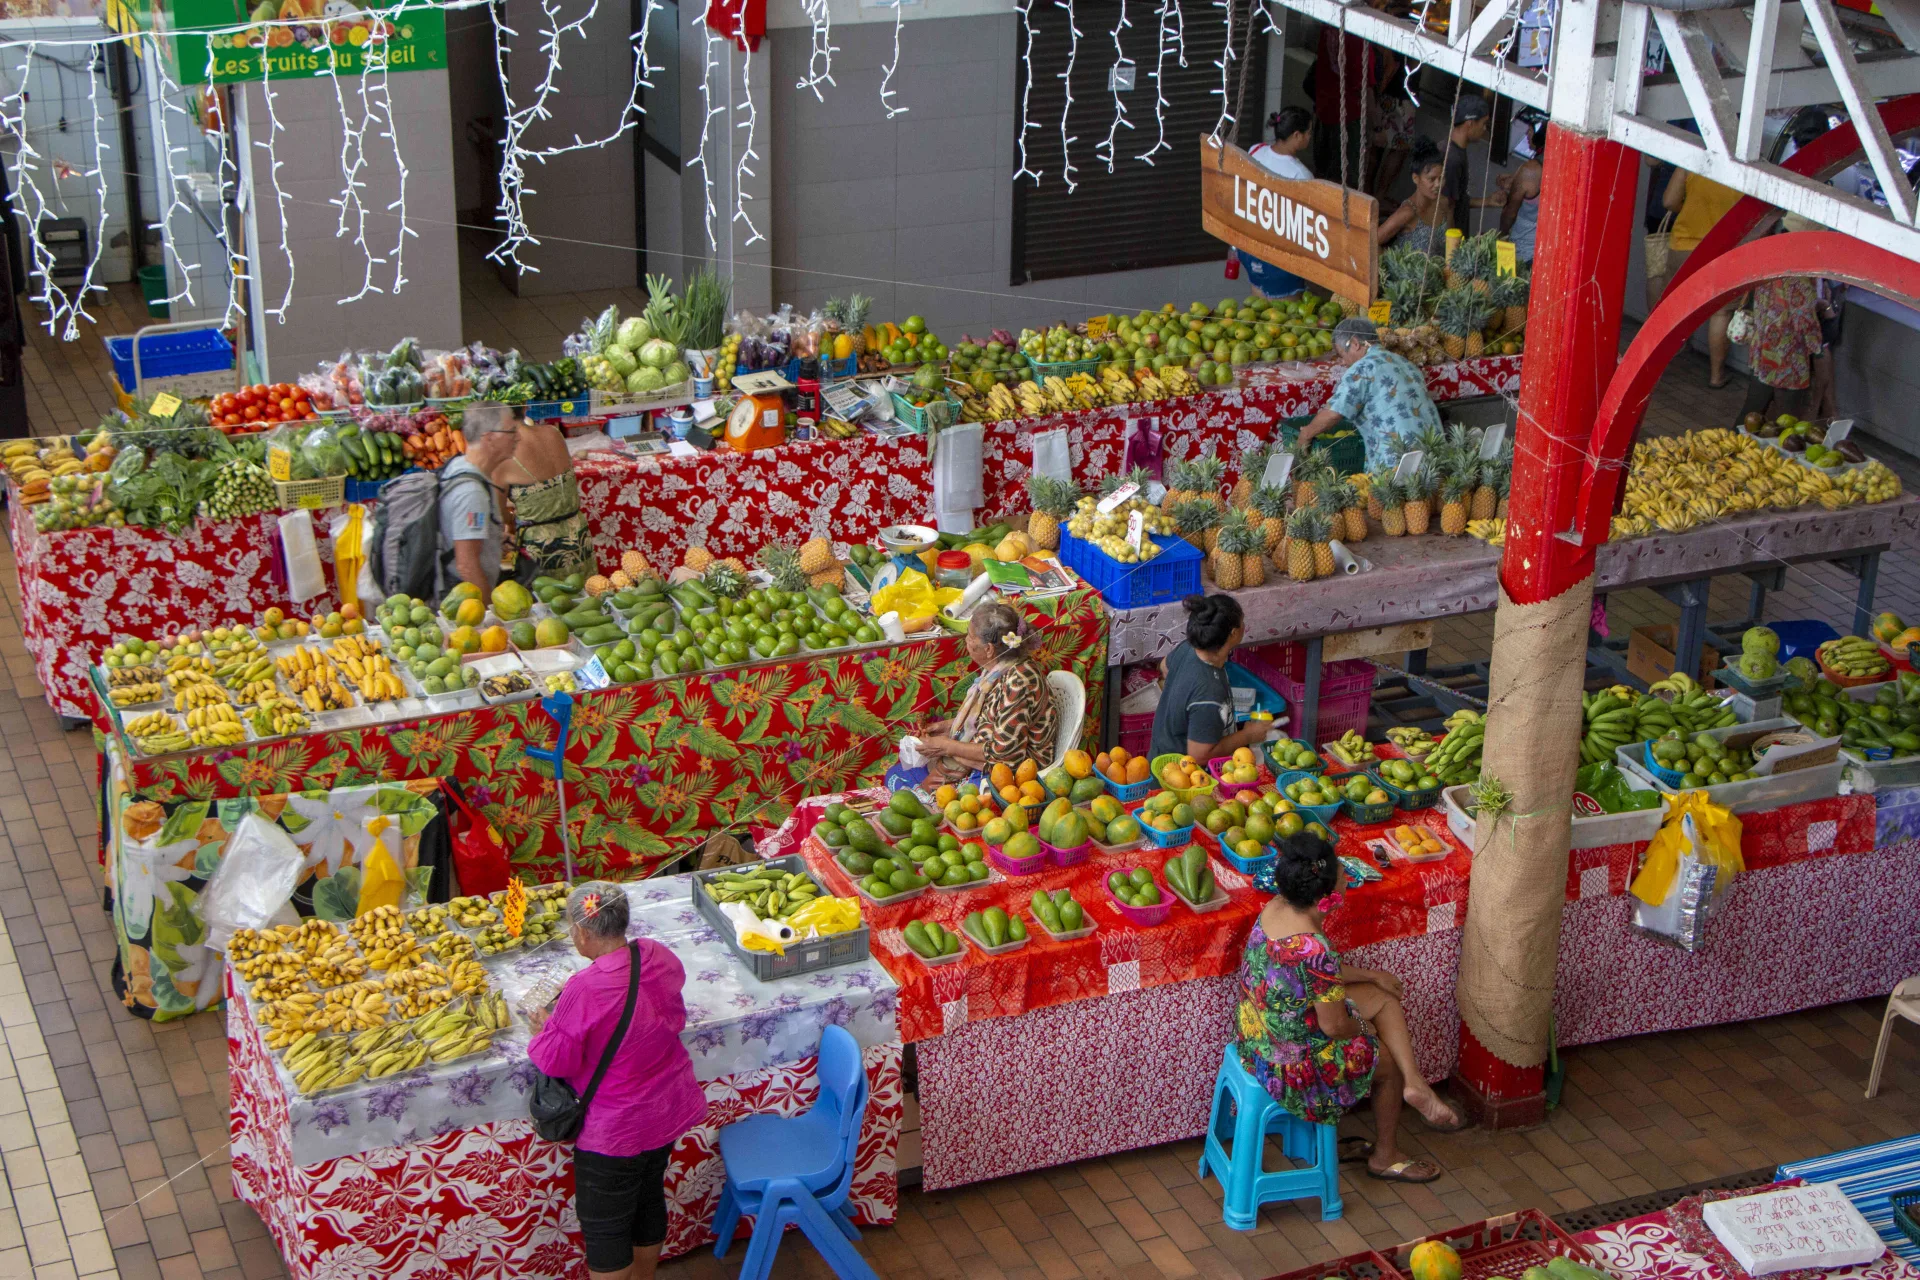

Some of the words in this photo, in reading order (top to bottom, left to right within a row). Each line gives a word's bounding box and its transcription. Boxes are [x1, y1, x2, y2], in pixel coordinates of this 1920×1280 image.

[211, 57, 250, 75] Les
[258, 51, 319, 73] fruits
[326, 49, 352, 68] du
[360, 45, 416, 66] soleil
[1234, 174, 1330, 259] LEGUMES
